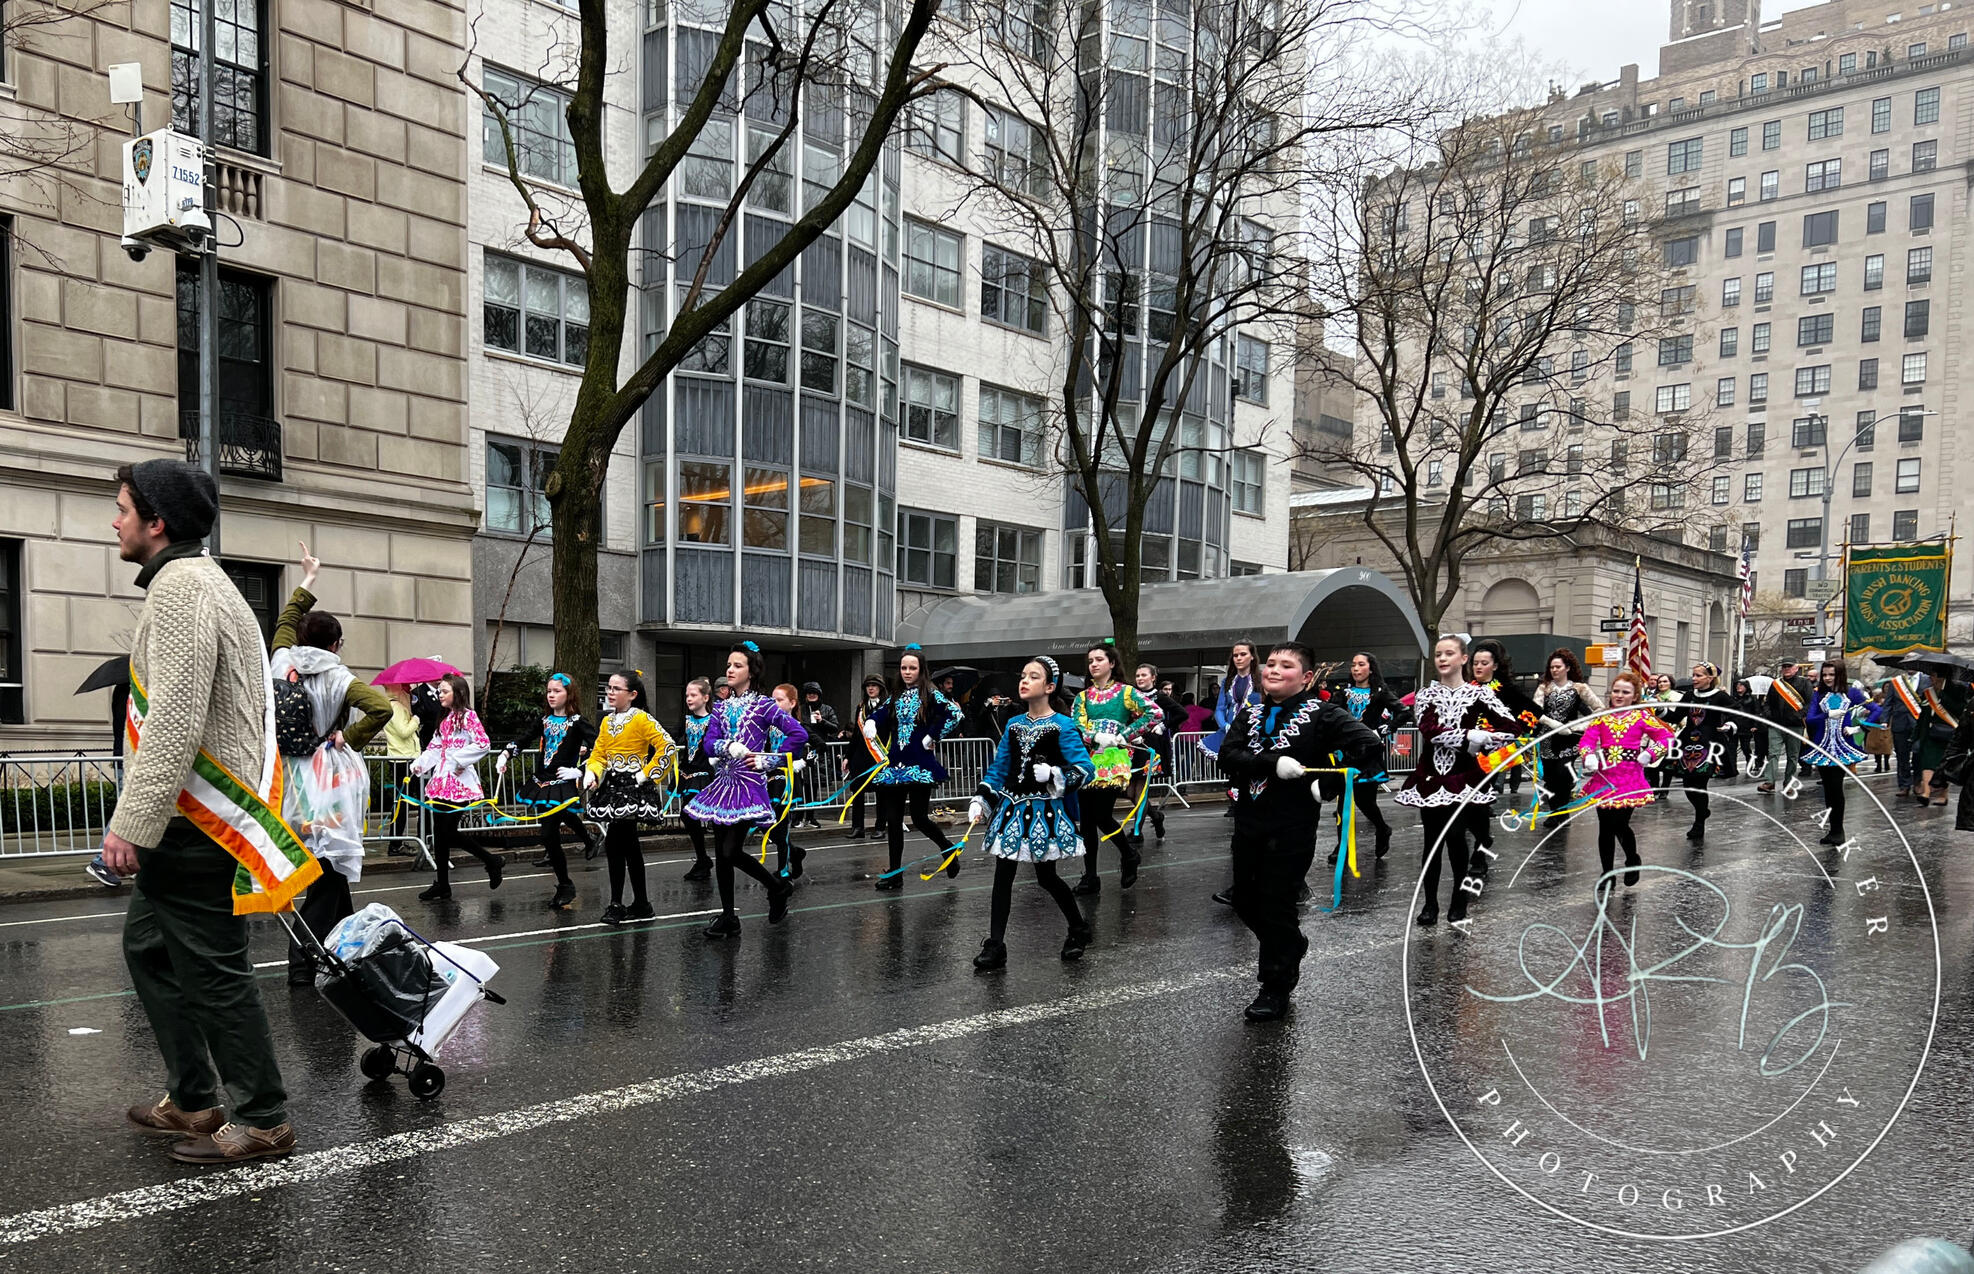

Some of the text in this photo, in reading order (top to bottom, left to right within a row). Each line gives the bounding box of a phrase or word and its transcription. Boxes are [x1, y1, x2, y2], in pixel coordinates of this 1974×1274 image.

[1849, 562, 1891, 574] PARENTS
[1897, 559, 1945, 572] STUDENTS
[1861, 574, 1931, 600] IRISH DANCING
[1859, 599, 1933, 630] MUSIC ASSOCIATION
